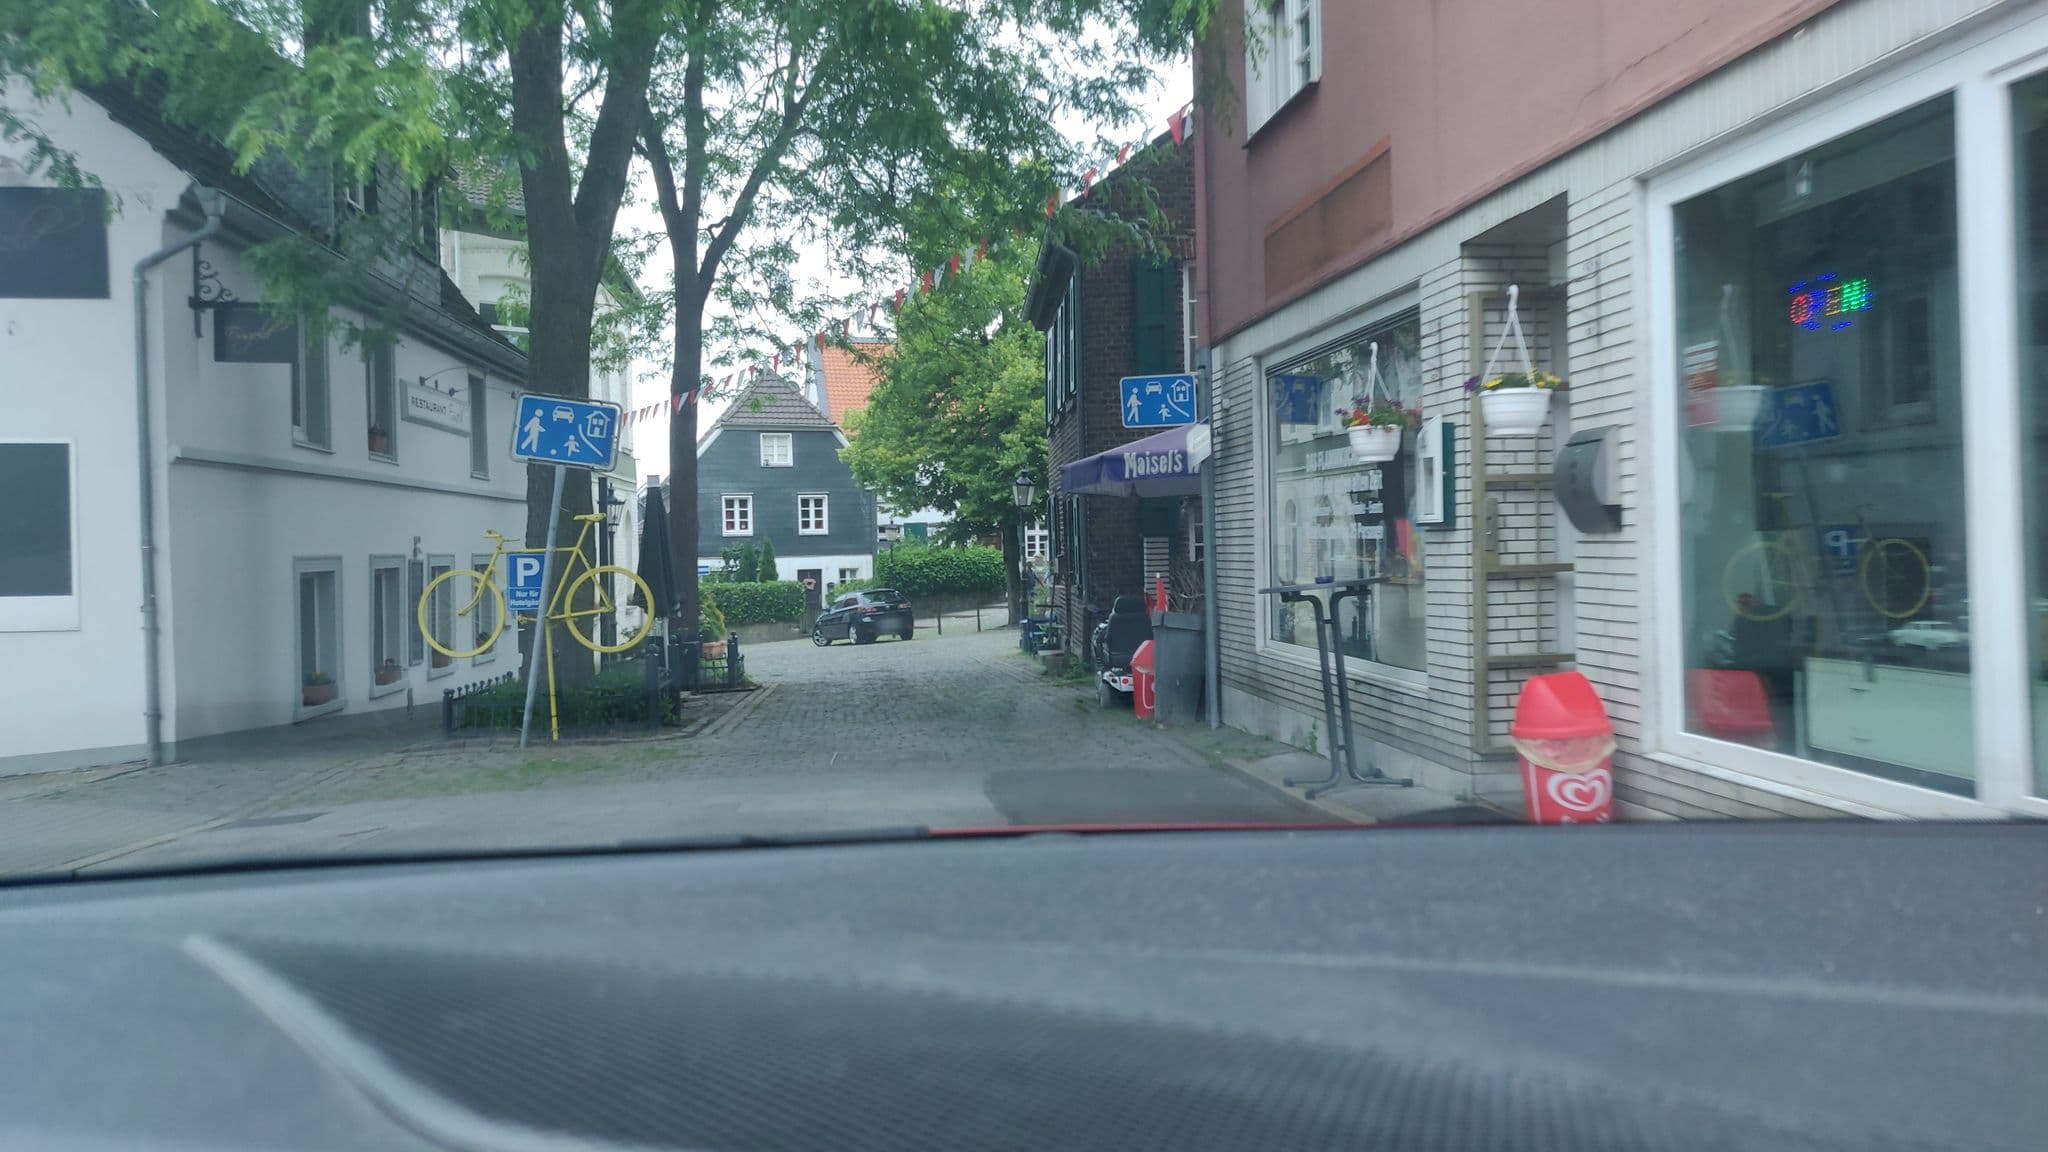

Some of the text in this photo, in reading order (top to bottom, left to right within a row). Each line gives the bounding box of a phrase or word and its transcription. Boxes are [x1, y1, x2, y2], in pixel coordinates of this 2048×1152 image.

[1790, 279, 1867, 324] OPEN
[1123, 449, 1183, 479] Maisel's
[516, 557, 540, 587] P
